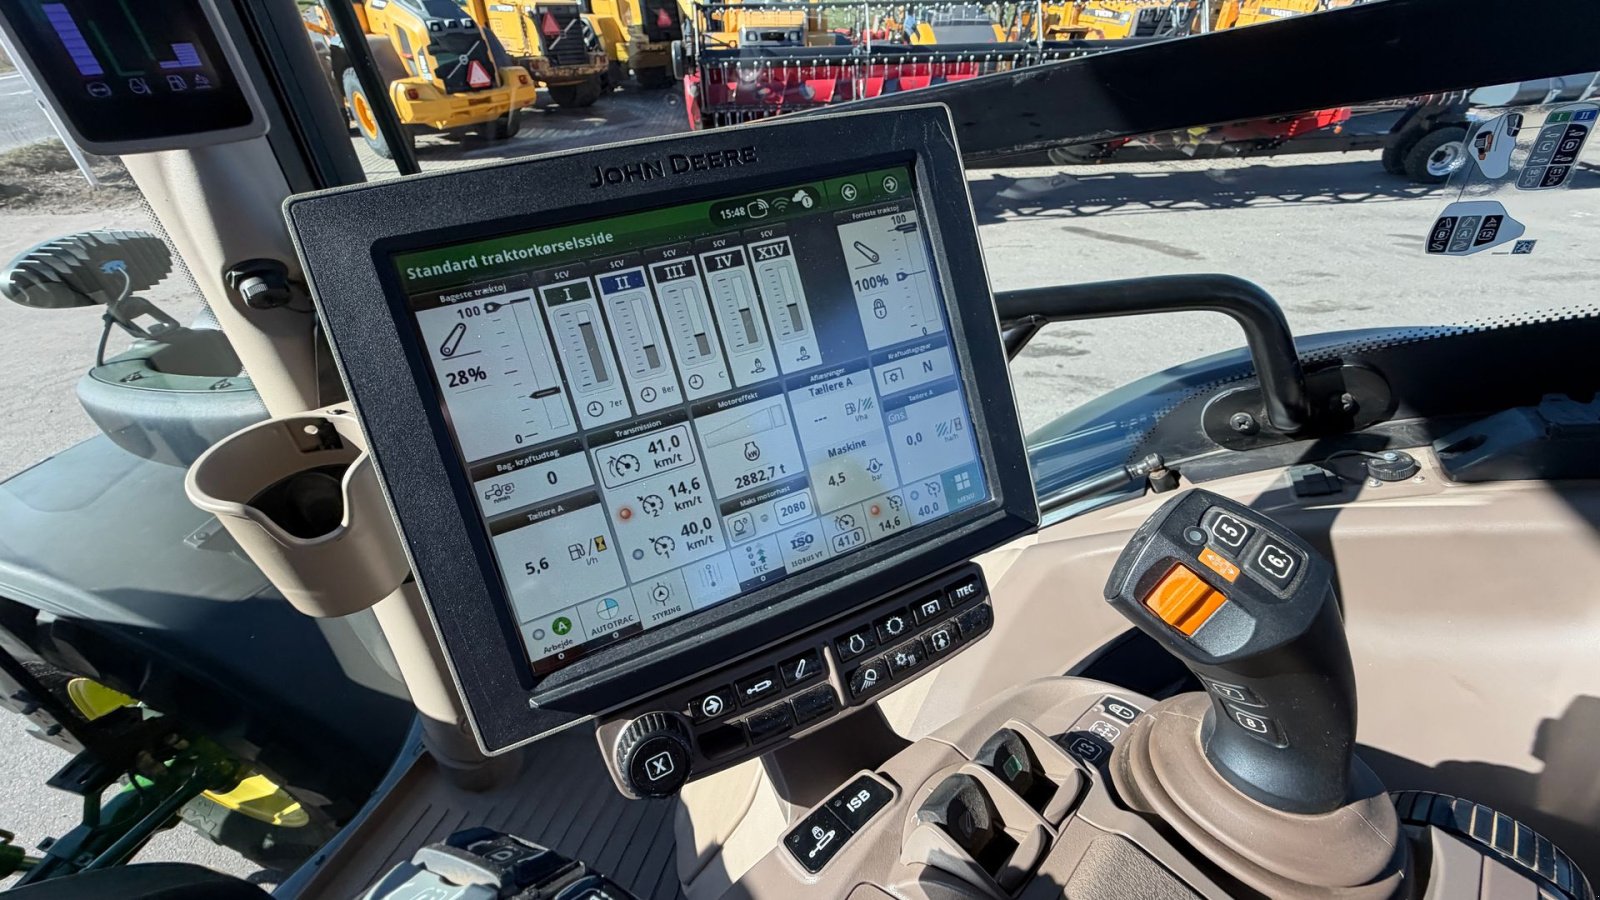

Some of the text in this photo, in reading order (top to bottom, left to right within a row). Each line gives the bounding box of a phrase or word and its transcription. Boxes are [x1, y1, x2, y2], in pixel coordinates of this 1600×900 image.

[1580, 112, 1589, 120] II
[590, 146, 759, 188] JOHN DEERE
[720, 207, 746, 220] 15:48
[891, 214, 907, 225] 100
[760, 230, 773, 238] SCV
[713, 239, 726, 248] SCV
[407, 232, 614, 280] Standard traktorkørselsside
[662, 249, 677, 258] SCV
[756, 243, 785, 260] XIV
[610, 260, 625, 269] SCV
[714, 254, 733, 269] IV
[554, 270, 570, 280] SCV
[664, 264, 686, 280] III
[615, 276, 631, 290] II
[854, 273, 889, 292] 100%
[440, 291, 472, 303] Bageste
[562, 288, 573, 301] I
[457, 305, 481, 319] 100
[922, 326, 928, 336] 0
[922, 360, 933, 373] N
[446, 366, 487, 388] 28%
[718, 371, 725, 379] C
[661, 385, 675, 394] 8er
[808, 377, 853, 397] Tællere A
[609, 399, 623, 409] 7er
[717, 392, 759, 409] Motoreffekt
[615, 420, 662, 438] Transmission
[515, 434, 523, 444] 0
[648, 434, 680, 454] 41,0
[906, 432, 923, 446] 0,0
[748, 450, 758, 458] kW
[828, 439, 867, 458] Maskine
[515, 449, 560, 466] kraftudtag
[654, 453, 682, 469] km/t
[547, 471, 558, 485] 0
[734, 463, 786, 490] 2882,7 t
[828, 472, 846, 487] 4,5
[872, 474, 882, 482] bar
[668, 477, 701, 498] 14,6
[674, 495, 703, 512] km/t
[740, 497, 757, 507] Maks
[957, 493, 975, 503] MENU
[527, 505, 564, 521] Tællere A
[652, 509, 659, 518] 2
[780, 501, 806, 517] 2080
[918, 502, 939, 517] 40,0
[681, 517, 712, 537] 40,0
[879, 516, 901, 532] 14,6
[1220, 523, 1239, 537] 5
[686, 535, 714, 551] km/t
[790, 534, 814, 550] ISO
[838, 531, 861, 548] 41,0
[664, 550, 670, 559] 1
[791, 551, 824, 568] ISOBUS VT
[525, 556, 549, 576] 5,6
[753, 564, 769, 575] iTEC
[955, 583, 975, 598] iTEC
[652, 605, 681, 621] STYRING
[557, 622, 568, 632] A
[591, 614, 634, 636] AUTOTRAC
[543, 638, 574, 654] Arbejde
[1246, 718, 1257, 728] 8
[1077, 743, 1095, 755] 13
[652, 757, 667, 775] X
[846, 790, 870, 813] ISB
